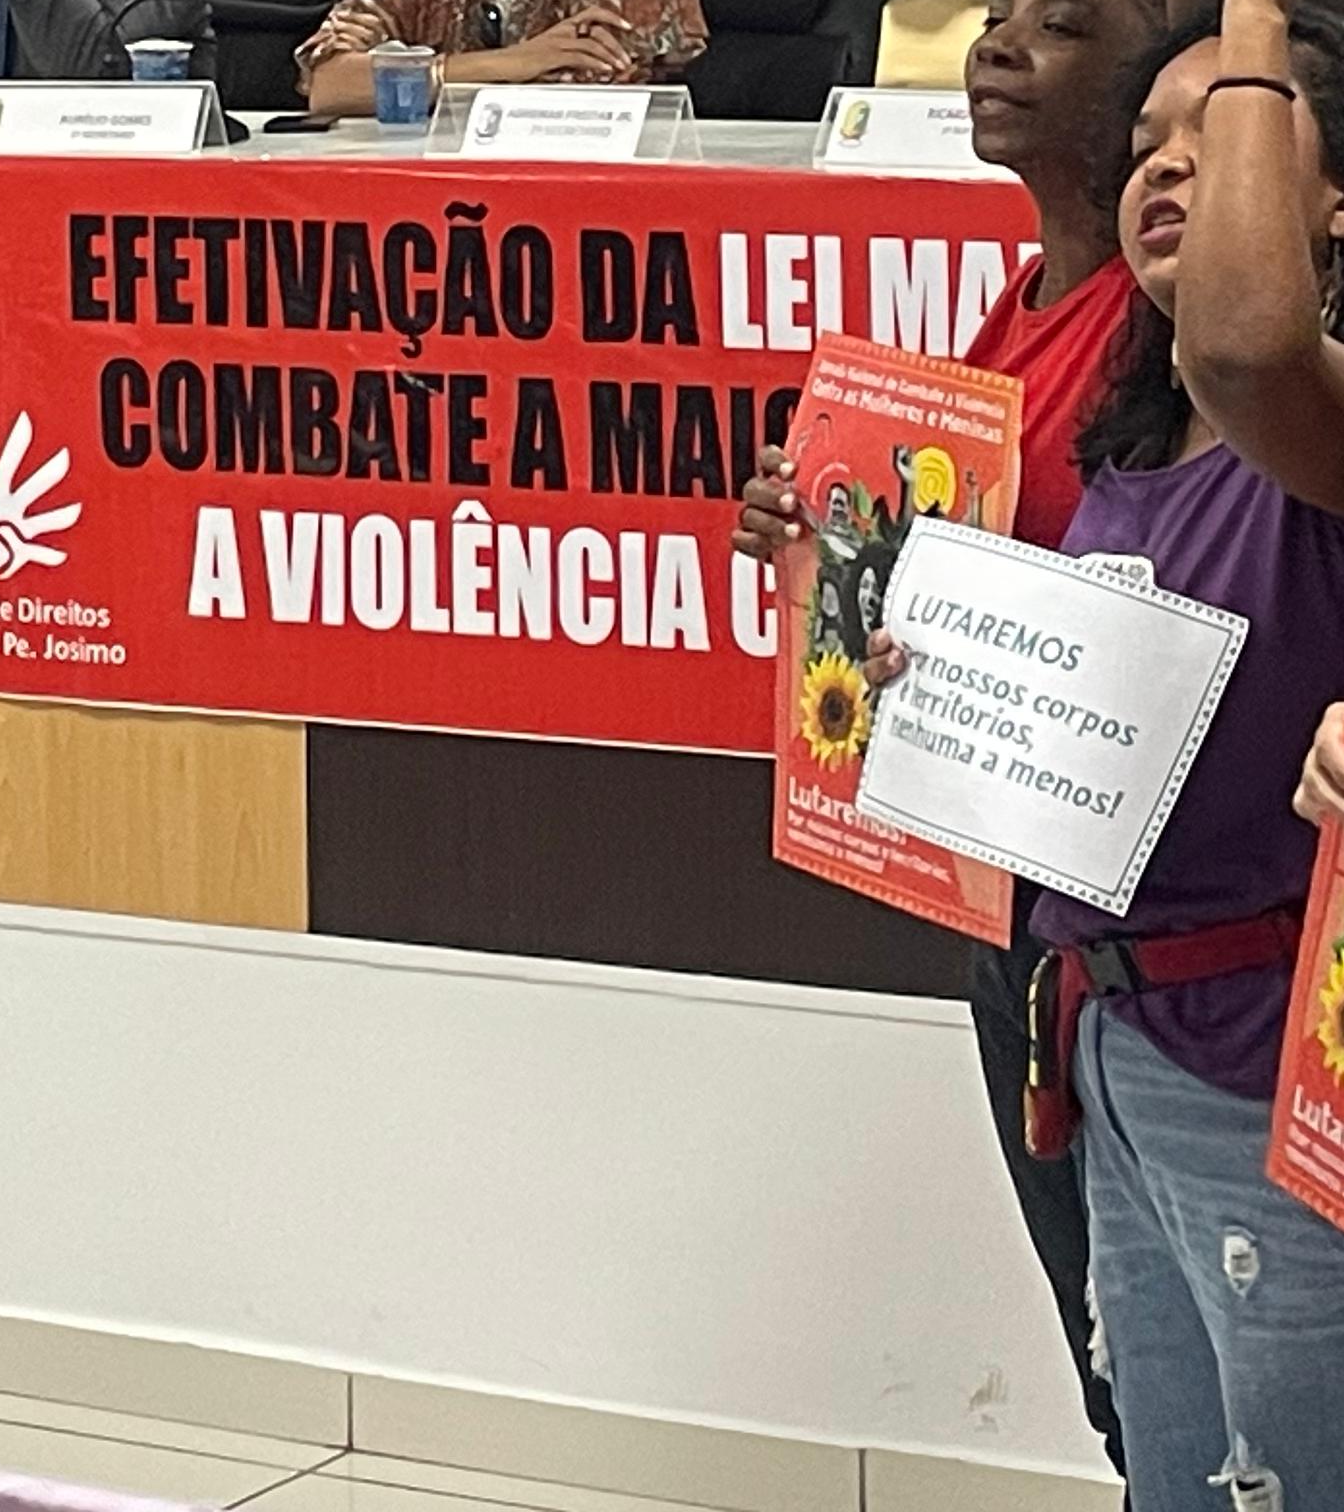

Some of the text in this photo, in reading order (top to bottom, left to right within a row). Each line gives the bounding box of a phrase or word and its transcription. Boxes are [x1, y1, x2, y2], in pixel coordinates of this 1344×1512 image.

[69, 200, 1044, 360] EFETIVAÇÃO DA LEI MA
[100, 357, 491, 487] COMBATE
[511, 377, 568, 491] A
[17, 596, 111, 628] Direitos
[188, 505, 247, 620] A
[259, 499, 711, 652] VIOLÊNCIA
[2, 632, 37, 659] Pe.
[43, 634, 127, 665] Josimo
[906, 592, 1084, 672] LUTAREMOS
[930, 650, 1030, 708] nossos
[1032, 692, 1139, 747] corpos
[980, 750, 1000, 774] a
[1005, 756, 1125, 821] menos!
